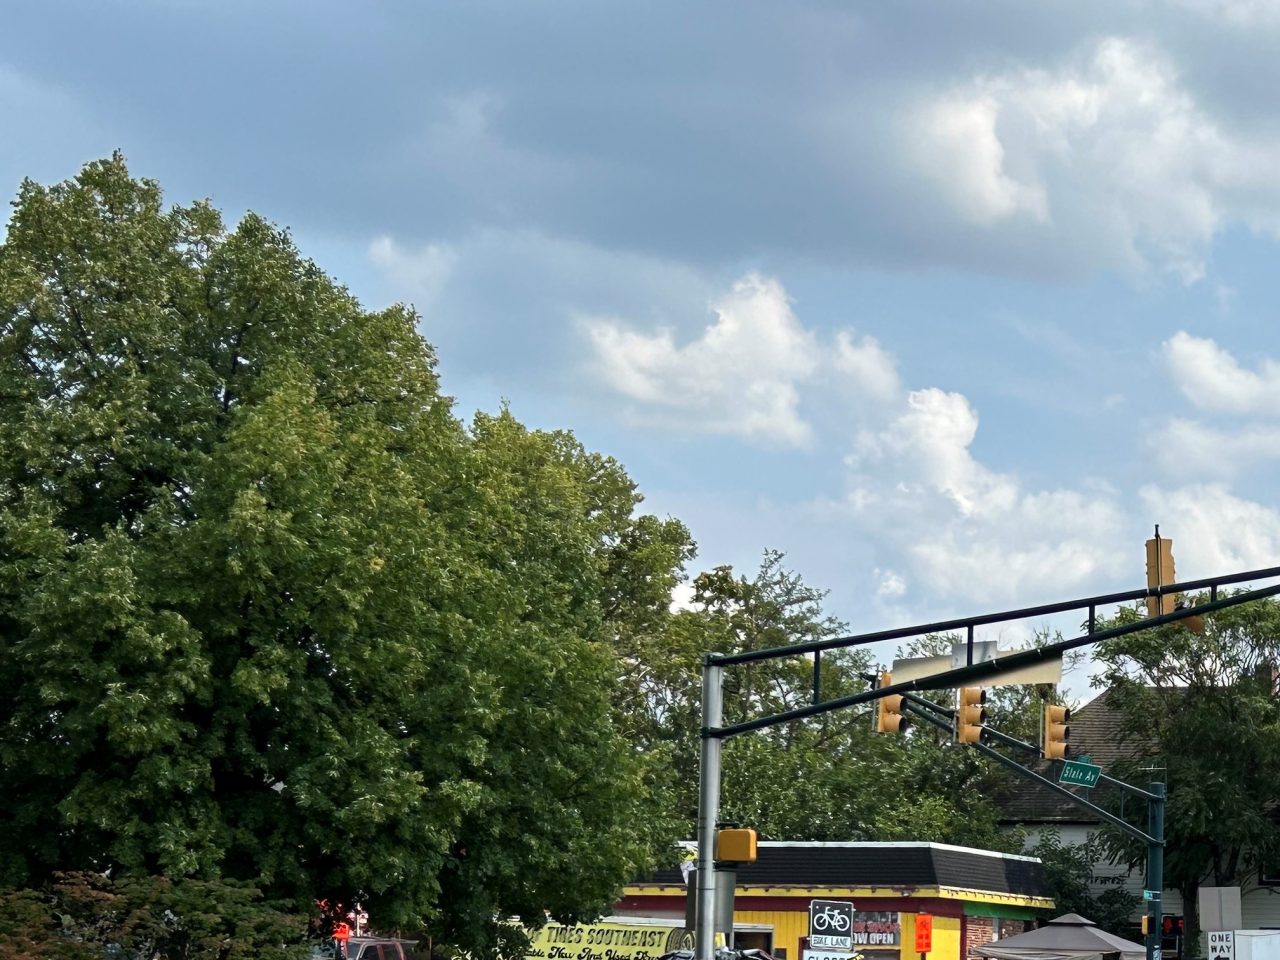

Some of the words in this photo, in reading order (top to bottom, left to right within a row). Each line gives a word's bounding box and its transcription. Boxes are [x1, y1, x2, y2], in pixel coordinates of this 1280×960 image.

[546, 926, 584, 944] TIRES
[586, 928, 666, 947] SOUTHEAST
[813, 936, 829, 946] BIKE
[830, 936, 849, 947] LANE
[853, 933, 868, 945] OW
[869, 933, 895, 945] OPEN
[1211, 933, 1231, 943] ONE
[547, 946, 574, 960] New
[1210, 945, 1231, 954] WAY
